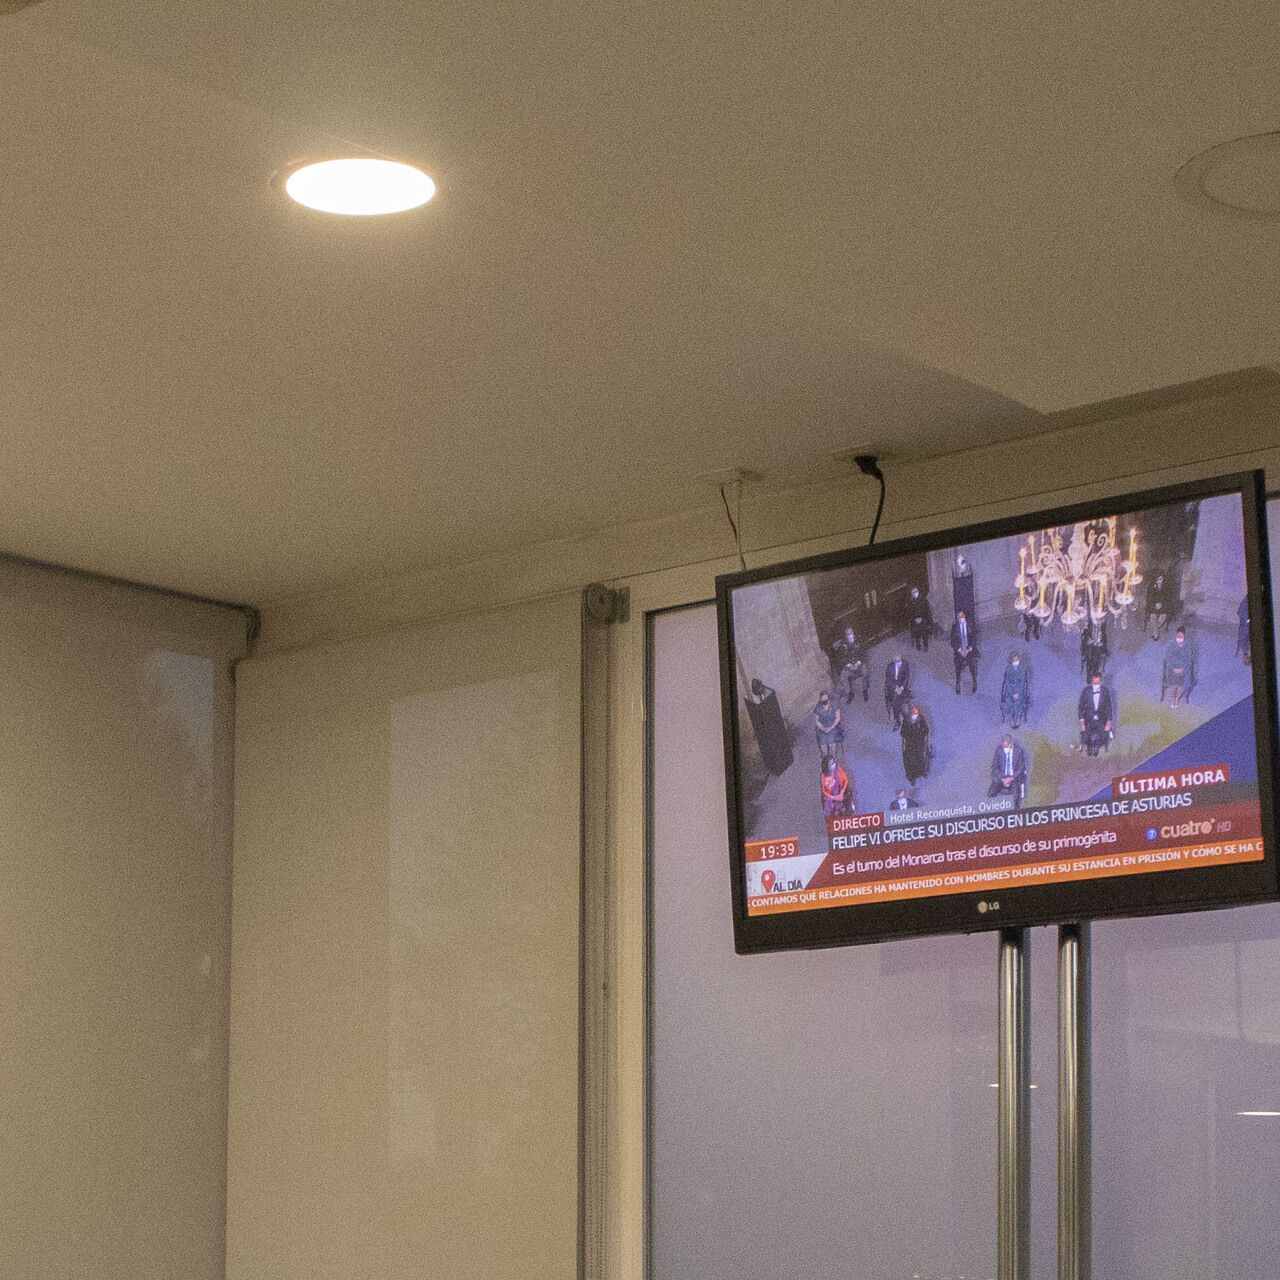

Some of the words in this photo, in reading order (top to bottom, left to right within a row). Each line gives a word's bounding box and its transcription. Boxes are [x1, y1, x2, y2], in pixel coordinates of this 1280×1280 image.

[1119, 776, 1177, 794] ÚLTIMA
[1181, 769, 1226, 786] HORA
[832, 833, 867, 850] FELIPE
[869, 832, 880, 846] VI
[883, 826, 925, 844] OFRECE
[928, 824, 943, 838] SU
[946, 817, 1005, 836] DISCURSO
[1007, 814, 1023, 828] EN
[1025, 810, 1048, 825] LOS
[1051, 803, 1110, 822] PRINCESA
[1112, 800, 1129, 815] DE
[1131, 792, 1192, 813] ASTURIAS
[833, 815, 880, 831] DIRECTO
[890, 811, 914, 824] Hotel
[978, 800, 1012, 812] Oviedo
[1161, 819, 1213, 838] cuatro
[760, 843, 795, 859] 19:39
[833, 863, 845, 875] Es
[847, 860, 855, 873] el
[885, 855, 900, 870] del
[902, 852, 944, 867] Monarca
[946, 848, 966, 862] tras
[968, 845, 977, 859] el
[979, 843, 1020, 858] discurso
[1022, 839, 1036, 853] de
[1038, 839, 1051, 852] su
[1053, 830, 1117, 851] primogénita
[752, 893, 798, 908] CONTAMOS
[820, 885, 872, 900] RELACIONES
[874, 883, 887, 894] HA
[889, 877, 943, 892] MANTENIDO
[944, 875, 964, 886] CON
[966, 870, 1010, 883] HOMBRES
[1012, 864, 1056, 878] DURANTE
[1058, 863, 1071, 873] SU
[1073, 858, 1121, 872] ESTANCIA
[1123, 856, 1136, 866] EN
[1138, 849, 1181, 864] PRISIÓN
[1183, 849, 1190, 859] Y
[1224, 844, 1237, 854] SE
[1239, 842, 1254, 853] HA
[773, 882, 786, 893] AL
